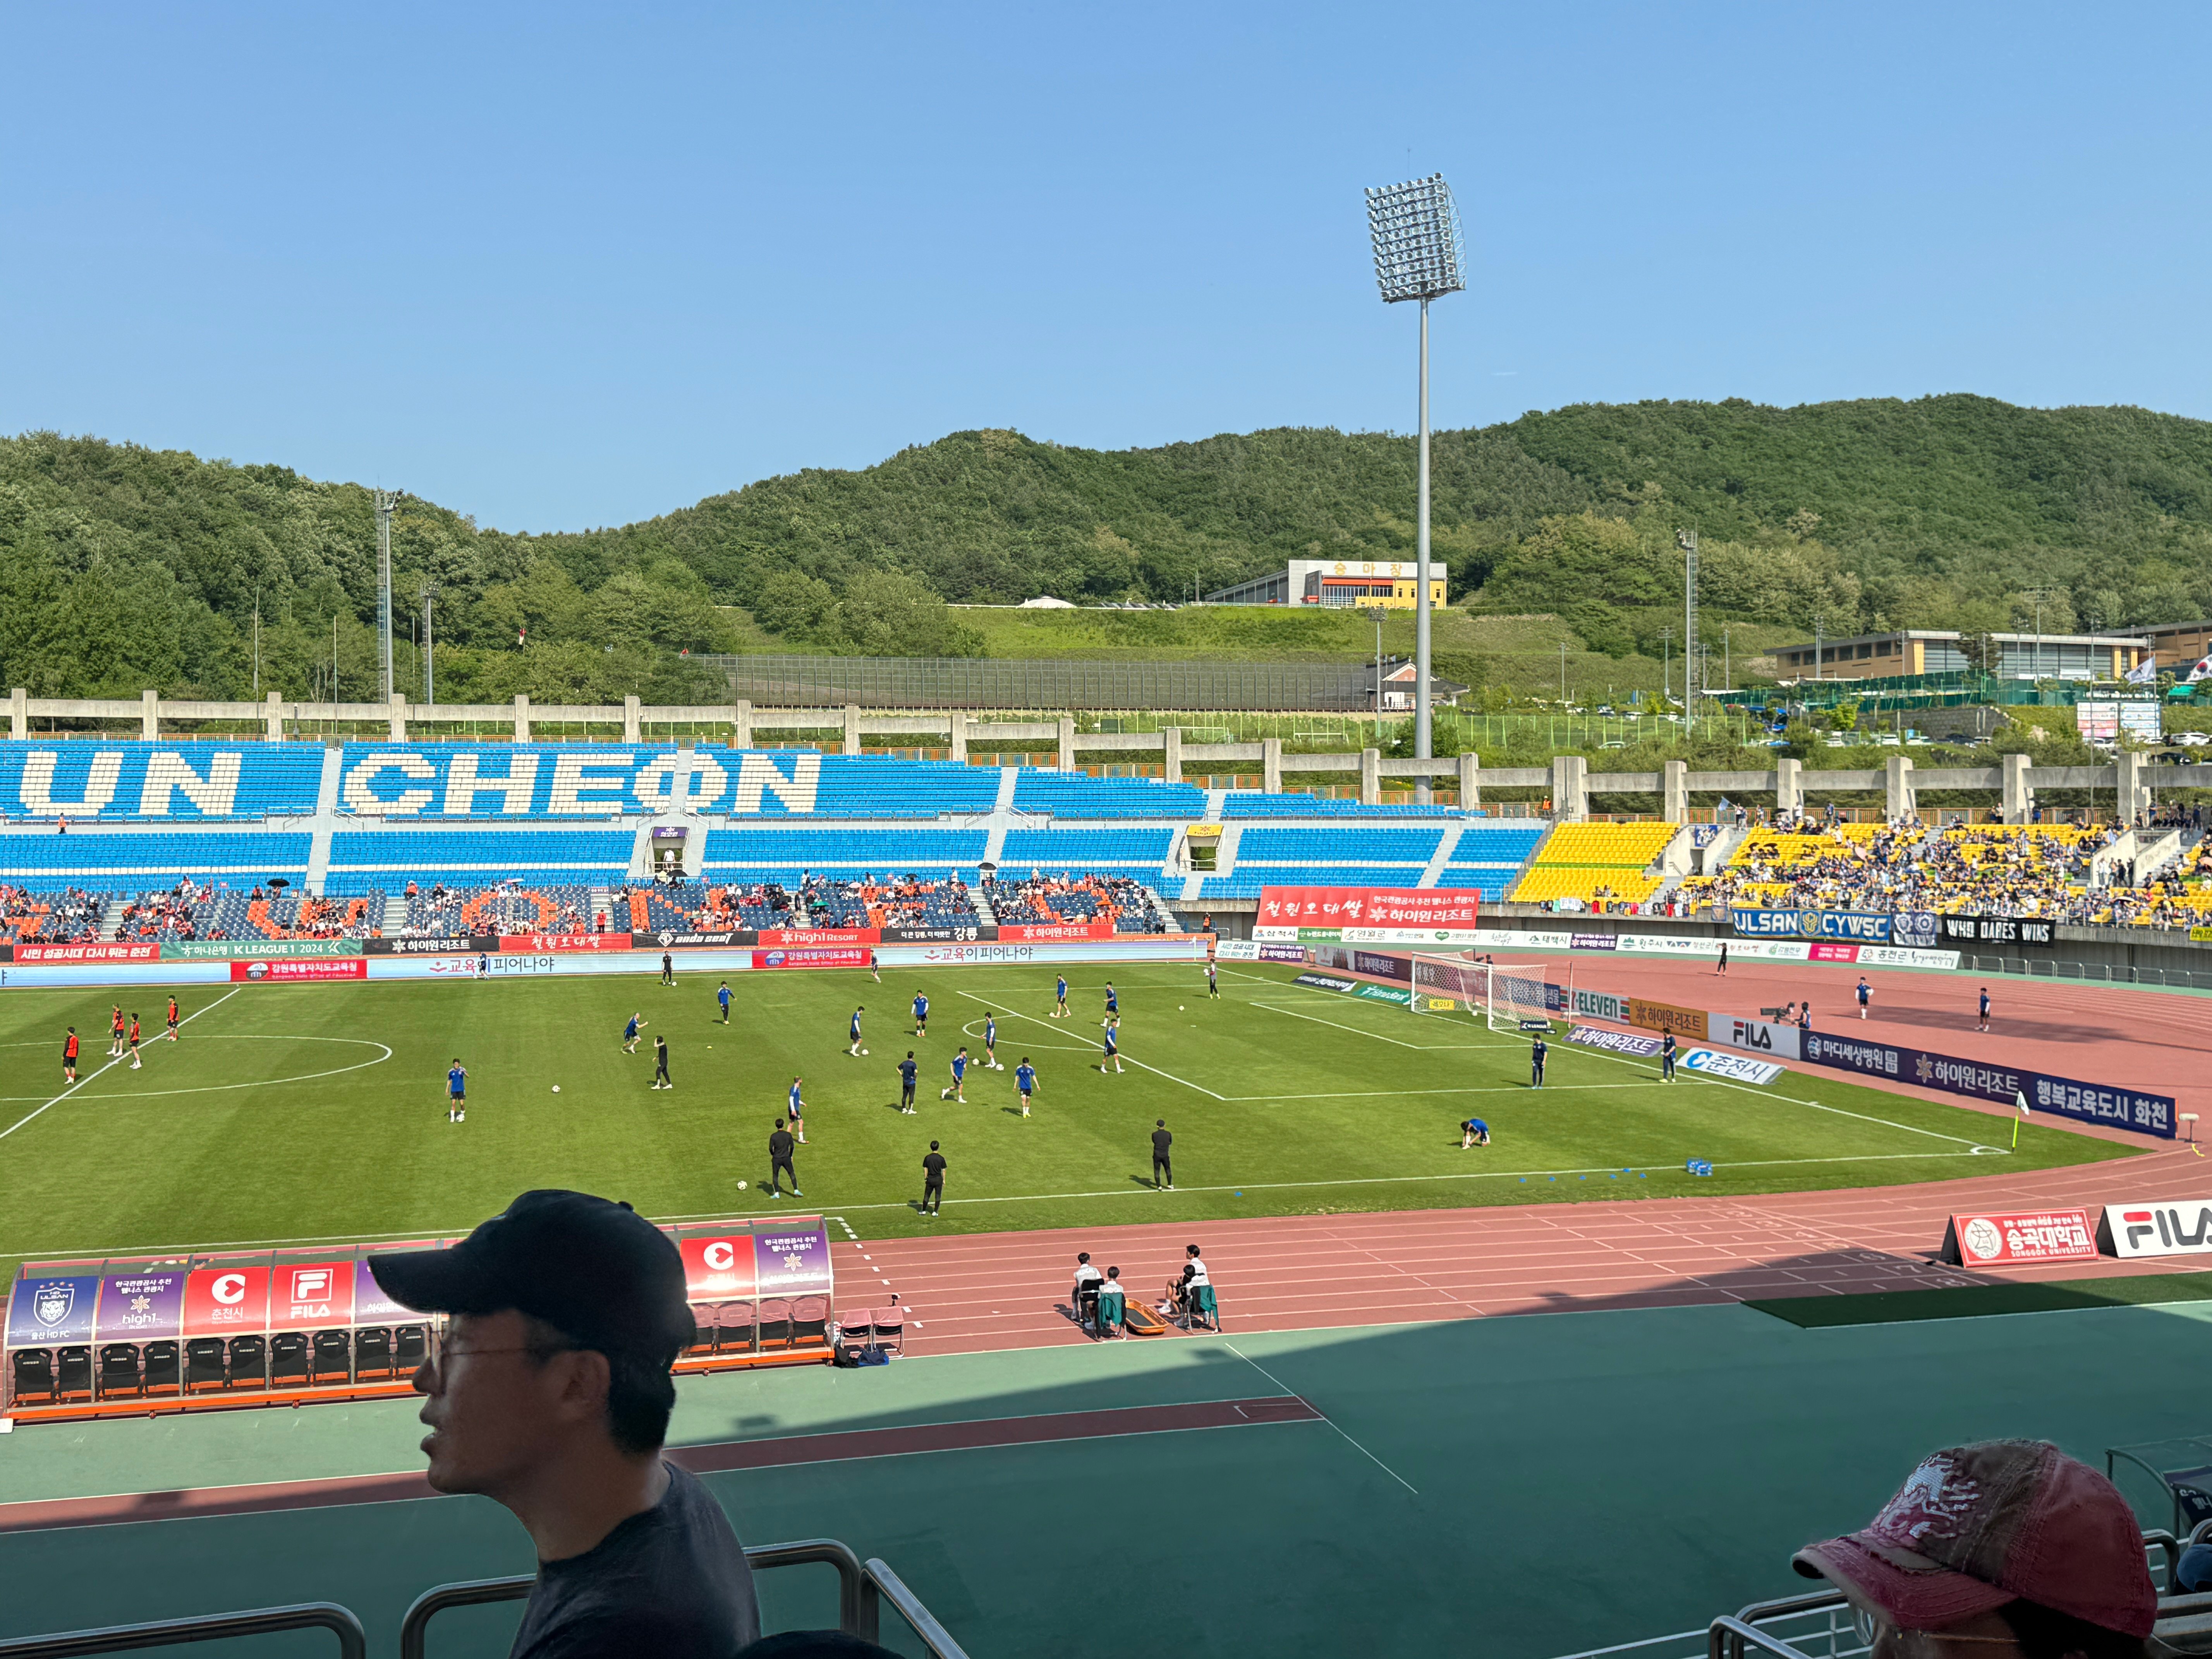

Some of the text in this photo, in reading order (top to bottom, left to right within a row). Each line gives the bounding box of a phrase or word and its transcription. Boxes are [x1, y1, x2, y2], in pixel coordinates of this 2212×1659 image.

[1334, 562, 1403, 577] 승마장
[1734, 912, 1798, 932] ULSAN
[795, 932, 825, 944] high1
[954, 927, 978, 941] 강릉
[1947, 919, 2050, 942] WHO DARES WINS
[21, 948, 41, 959] 시민
[86, 948, 105, 958] 다시
[109, 947, 128, 957] 뛰는
[234, 944, 323, 954] K LEAGUE 1 2024
[1733, 1021, 1771, 1049] FILA
[1824, 1040, 1883, 1070] 마디세상병원
[1707, 1055, 1769, 1081] 춘천시
[2037, 1080, 2167, 1130] 행복교육도시 화천
[2006, 1226, 2090, 1250] 송곡대학교
[2011, 1246, 2091, 1257] SONGGOK UNIVERSITY
[122, 1313, 156, 1325] high1
[212, 1307, 243, 1319] 춘천시
[290, 1304, 331, 1319] FILA
[32, 1332, 45, 1340] 울산
[60, 1330, 70, 1338] FC
